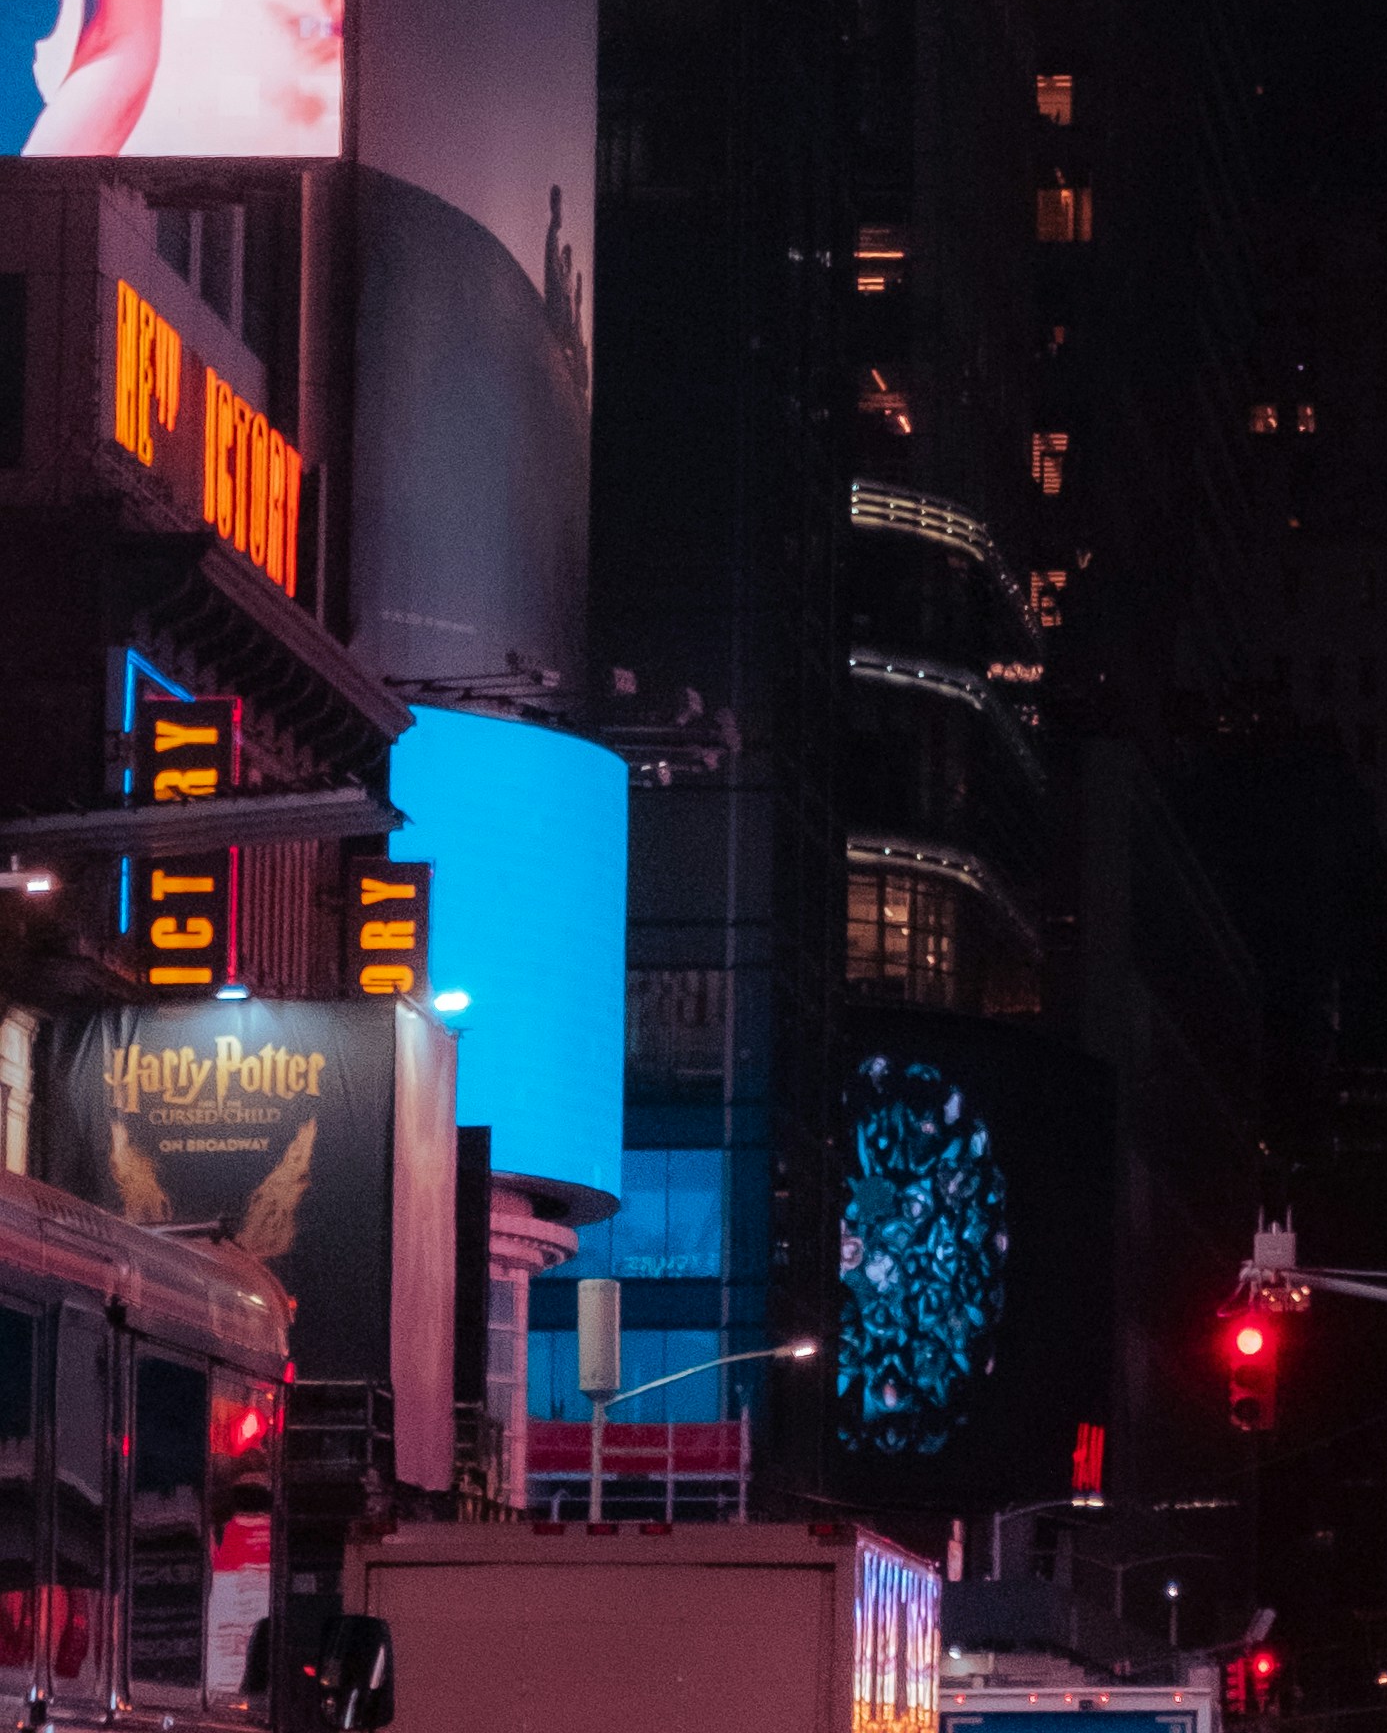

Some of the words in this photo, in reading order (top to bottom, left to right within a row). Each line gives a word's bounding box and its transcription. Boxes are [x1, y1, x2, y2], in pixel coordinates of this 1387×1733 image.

[204, 366, 302, 597] ICTORY
[104, 1043, 212, 1113] Harry
[215, 1035, 326, 1115] Potter
[158, 1139, 184, 1153] ON
[187, 1137, 271, 1152] BROADWAY
